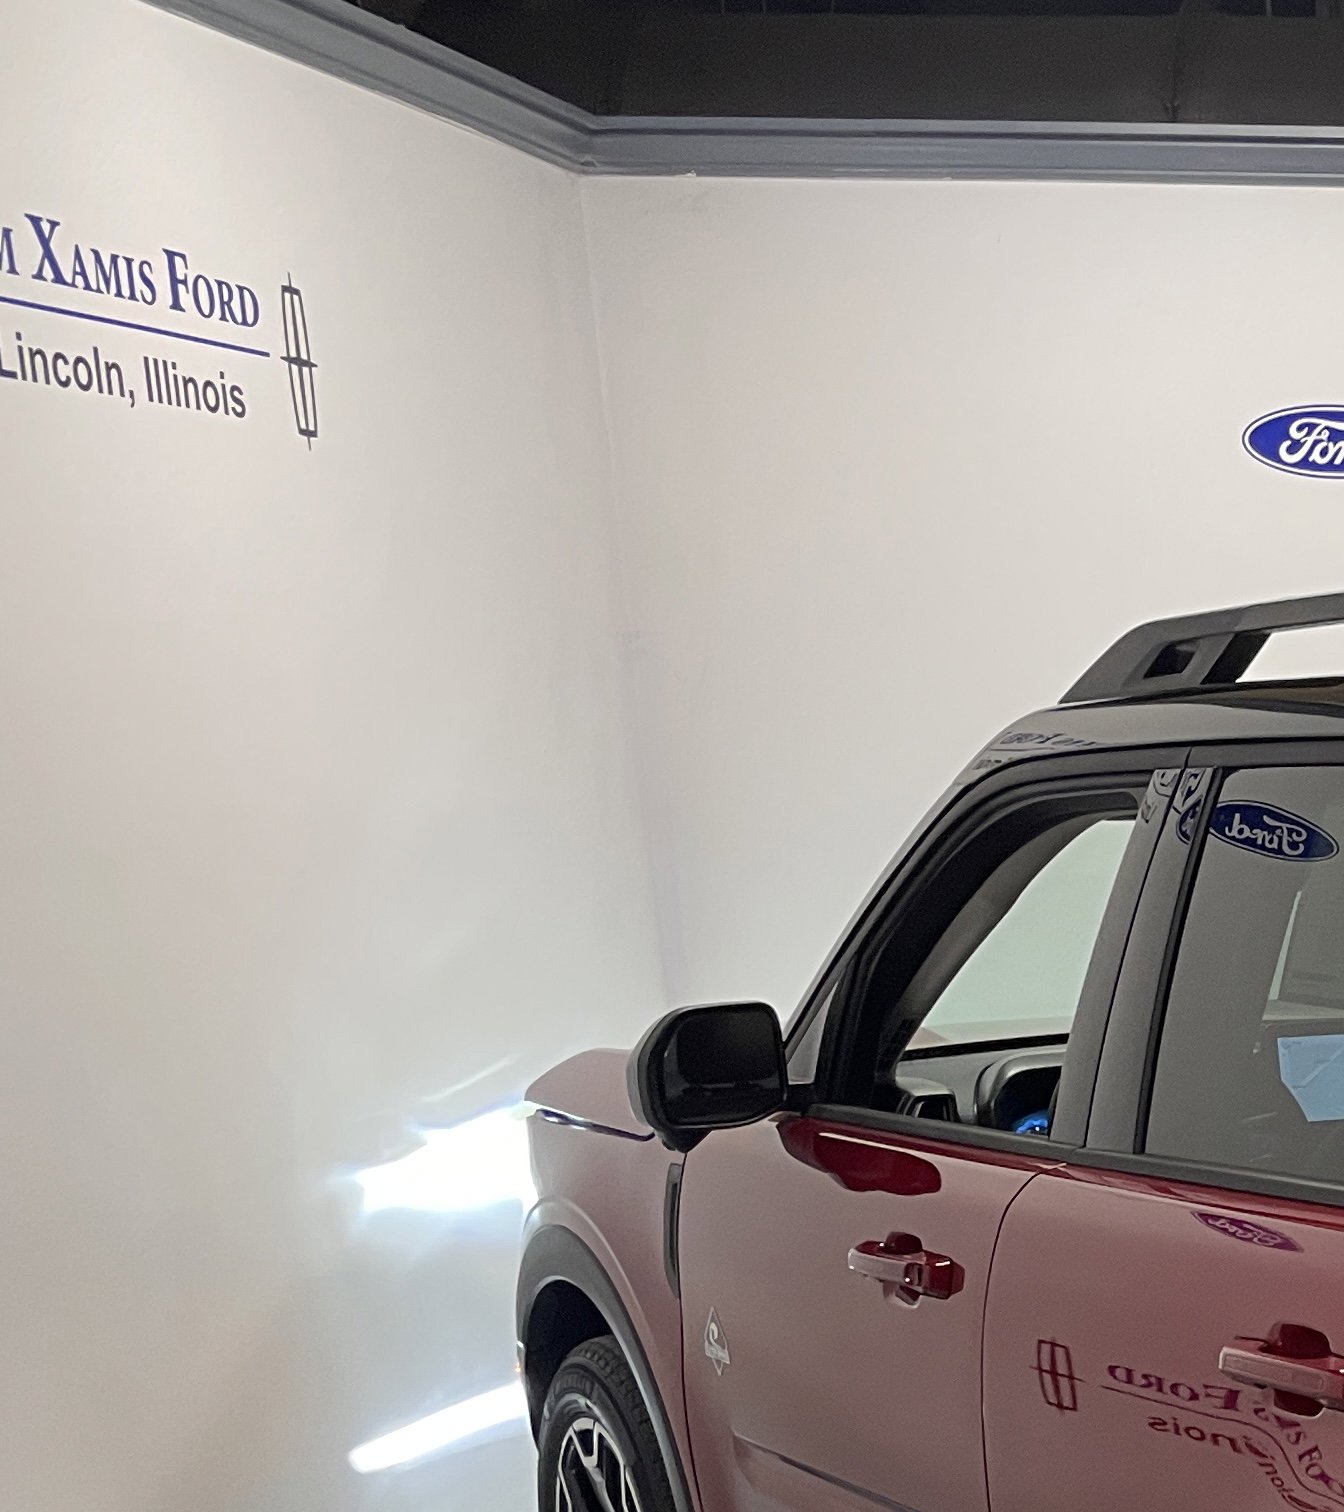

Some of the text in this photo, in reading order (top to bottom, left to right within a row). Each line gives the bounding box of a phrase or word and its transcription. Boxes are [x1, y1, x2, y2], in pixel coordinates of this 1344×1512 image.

[25, 214, 157, 305] XAMIS
[163, 249, 260, 328] FORD
[144, 356, 246, 418] Illinois
